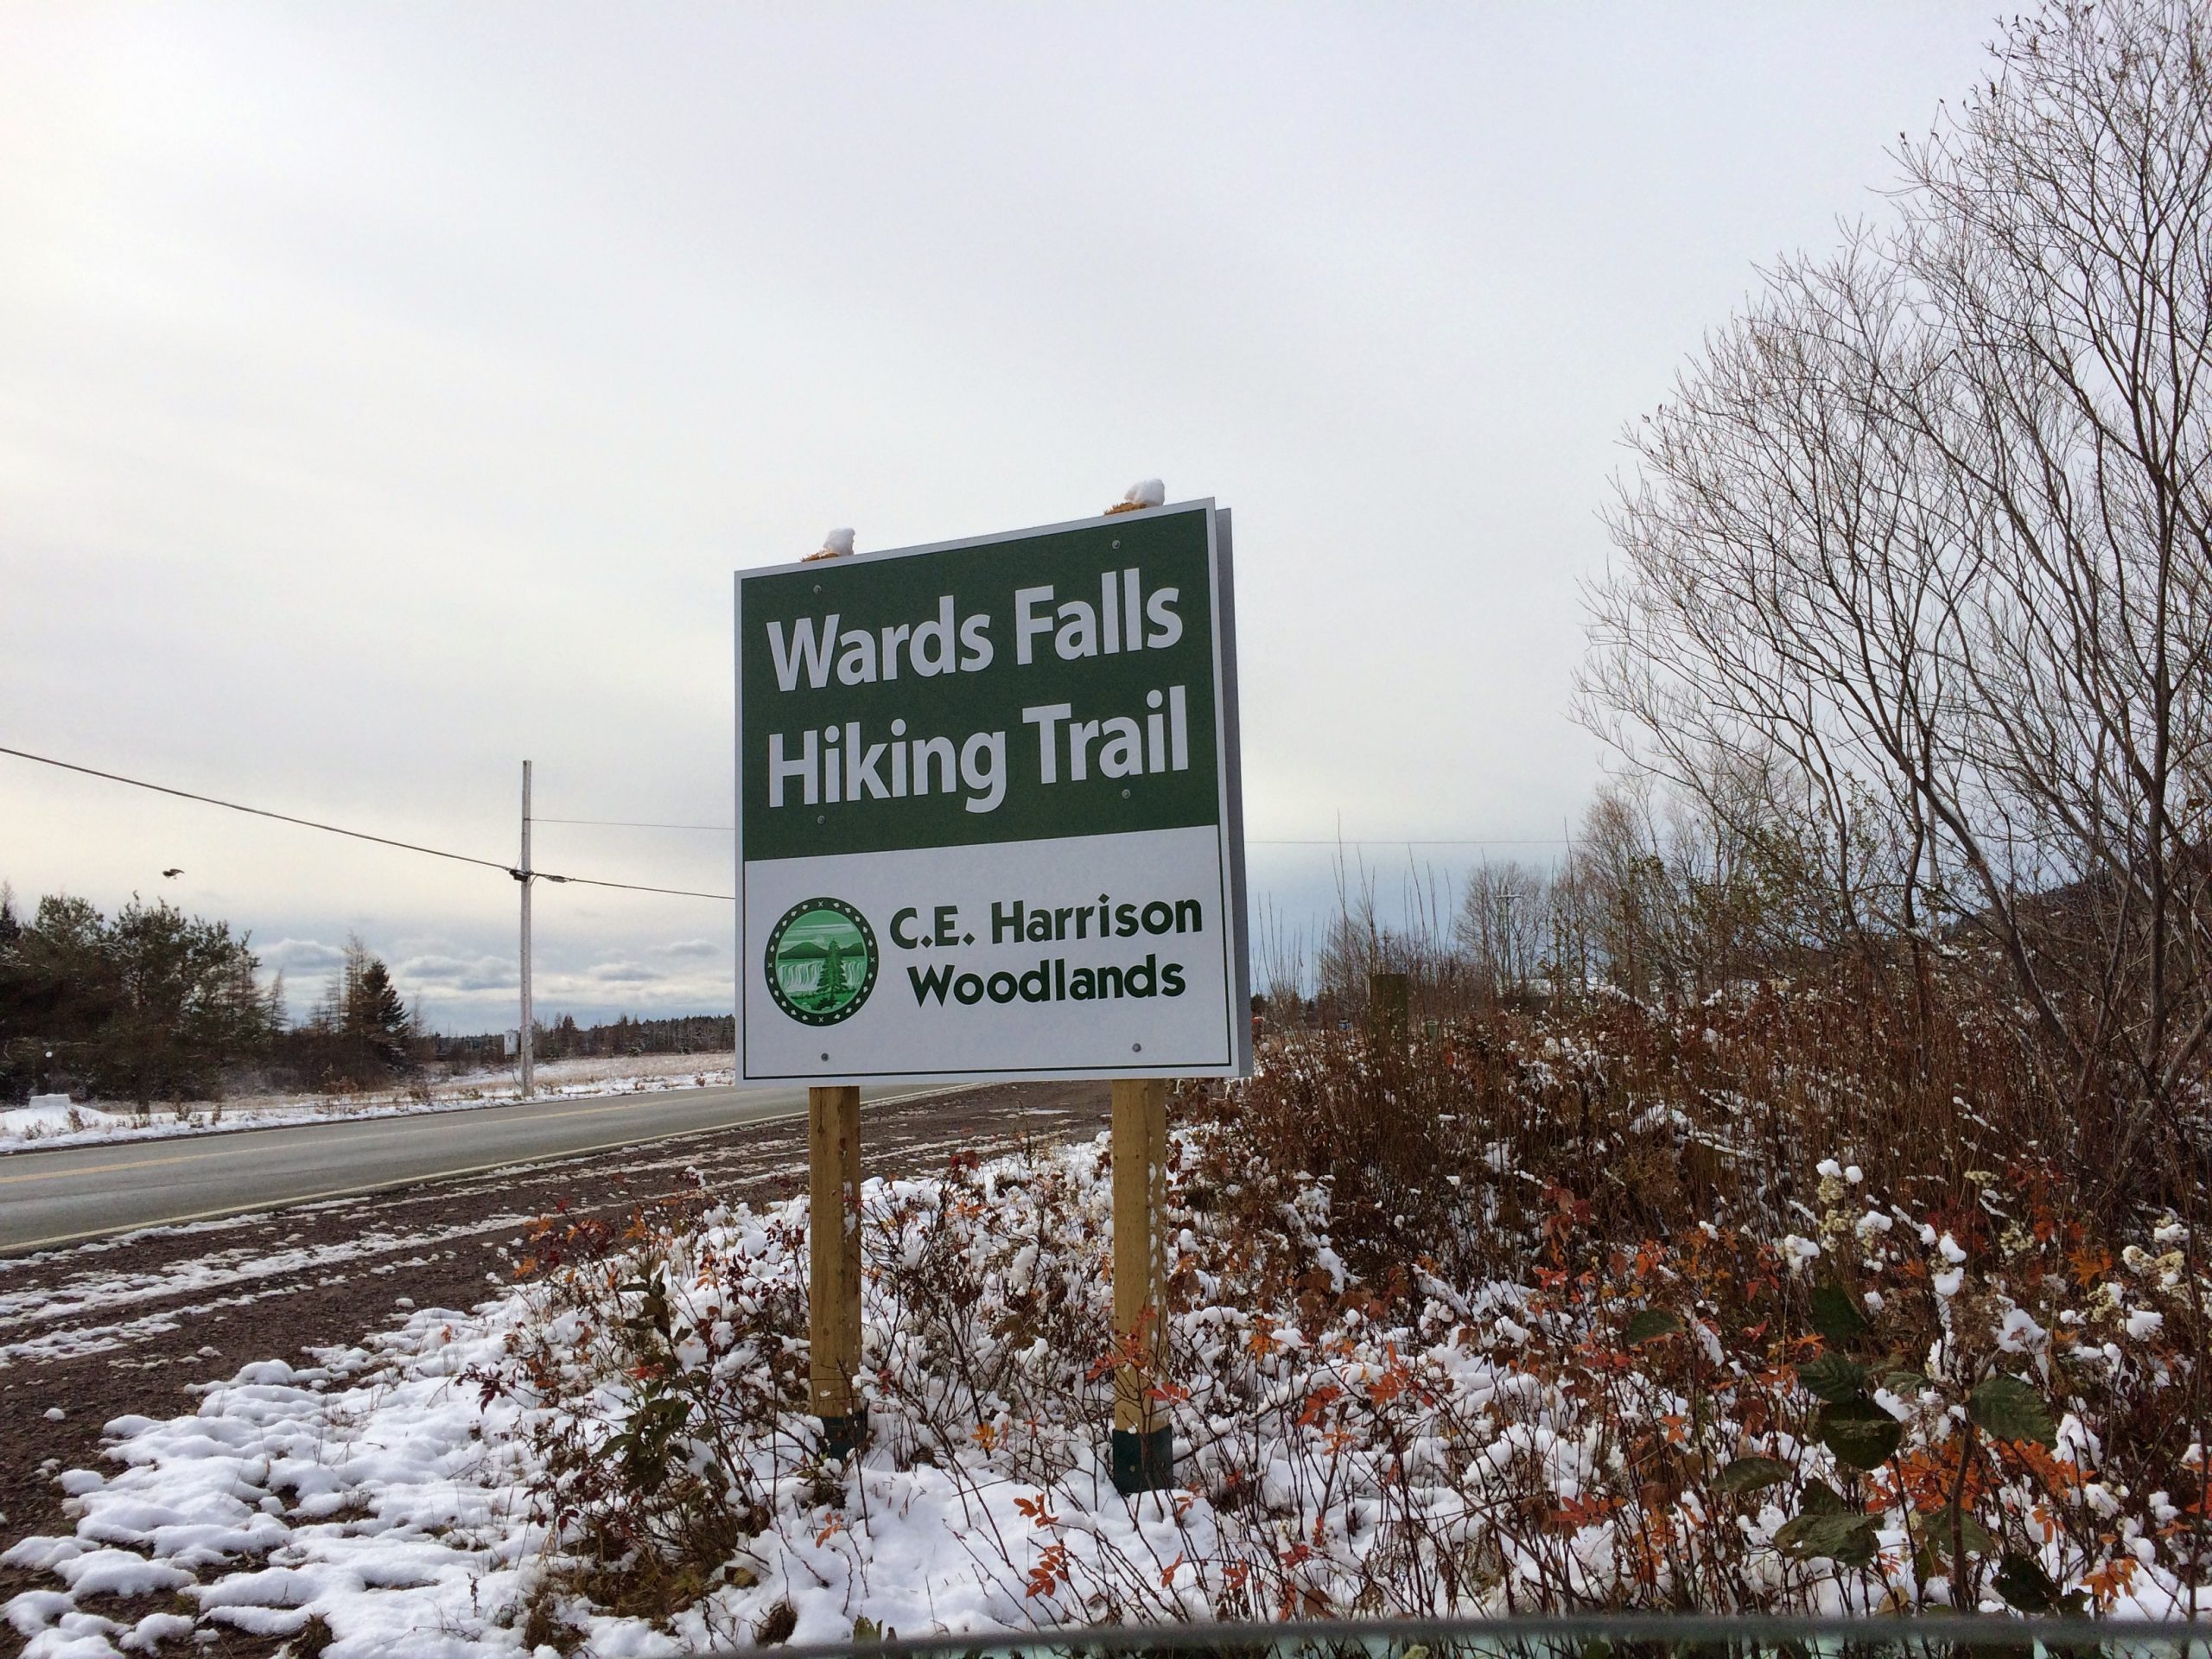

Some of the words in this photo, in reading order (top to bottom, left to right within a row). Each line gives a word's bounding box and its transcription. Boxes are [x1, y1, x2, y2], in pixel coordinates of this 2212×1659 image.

[766, 595, 994, 692] Wards
[1015, 569, 1183, 665] Falls
[769, 719, 1007, 812] Hiking
[1023, 686, 1188, 784] Trail
[890, 906, 975, 950] C.E.
[991, 893, 1203, 944] Harrison
[906, 953, 1186, 1007] Woodlands
